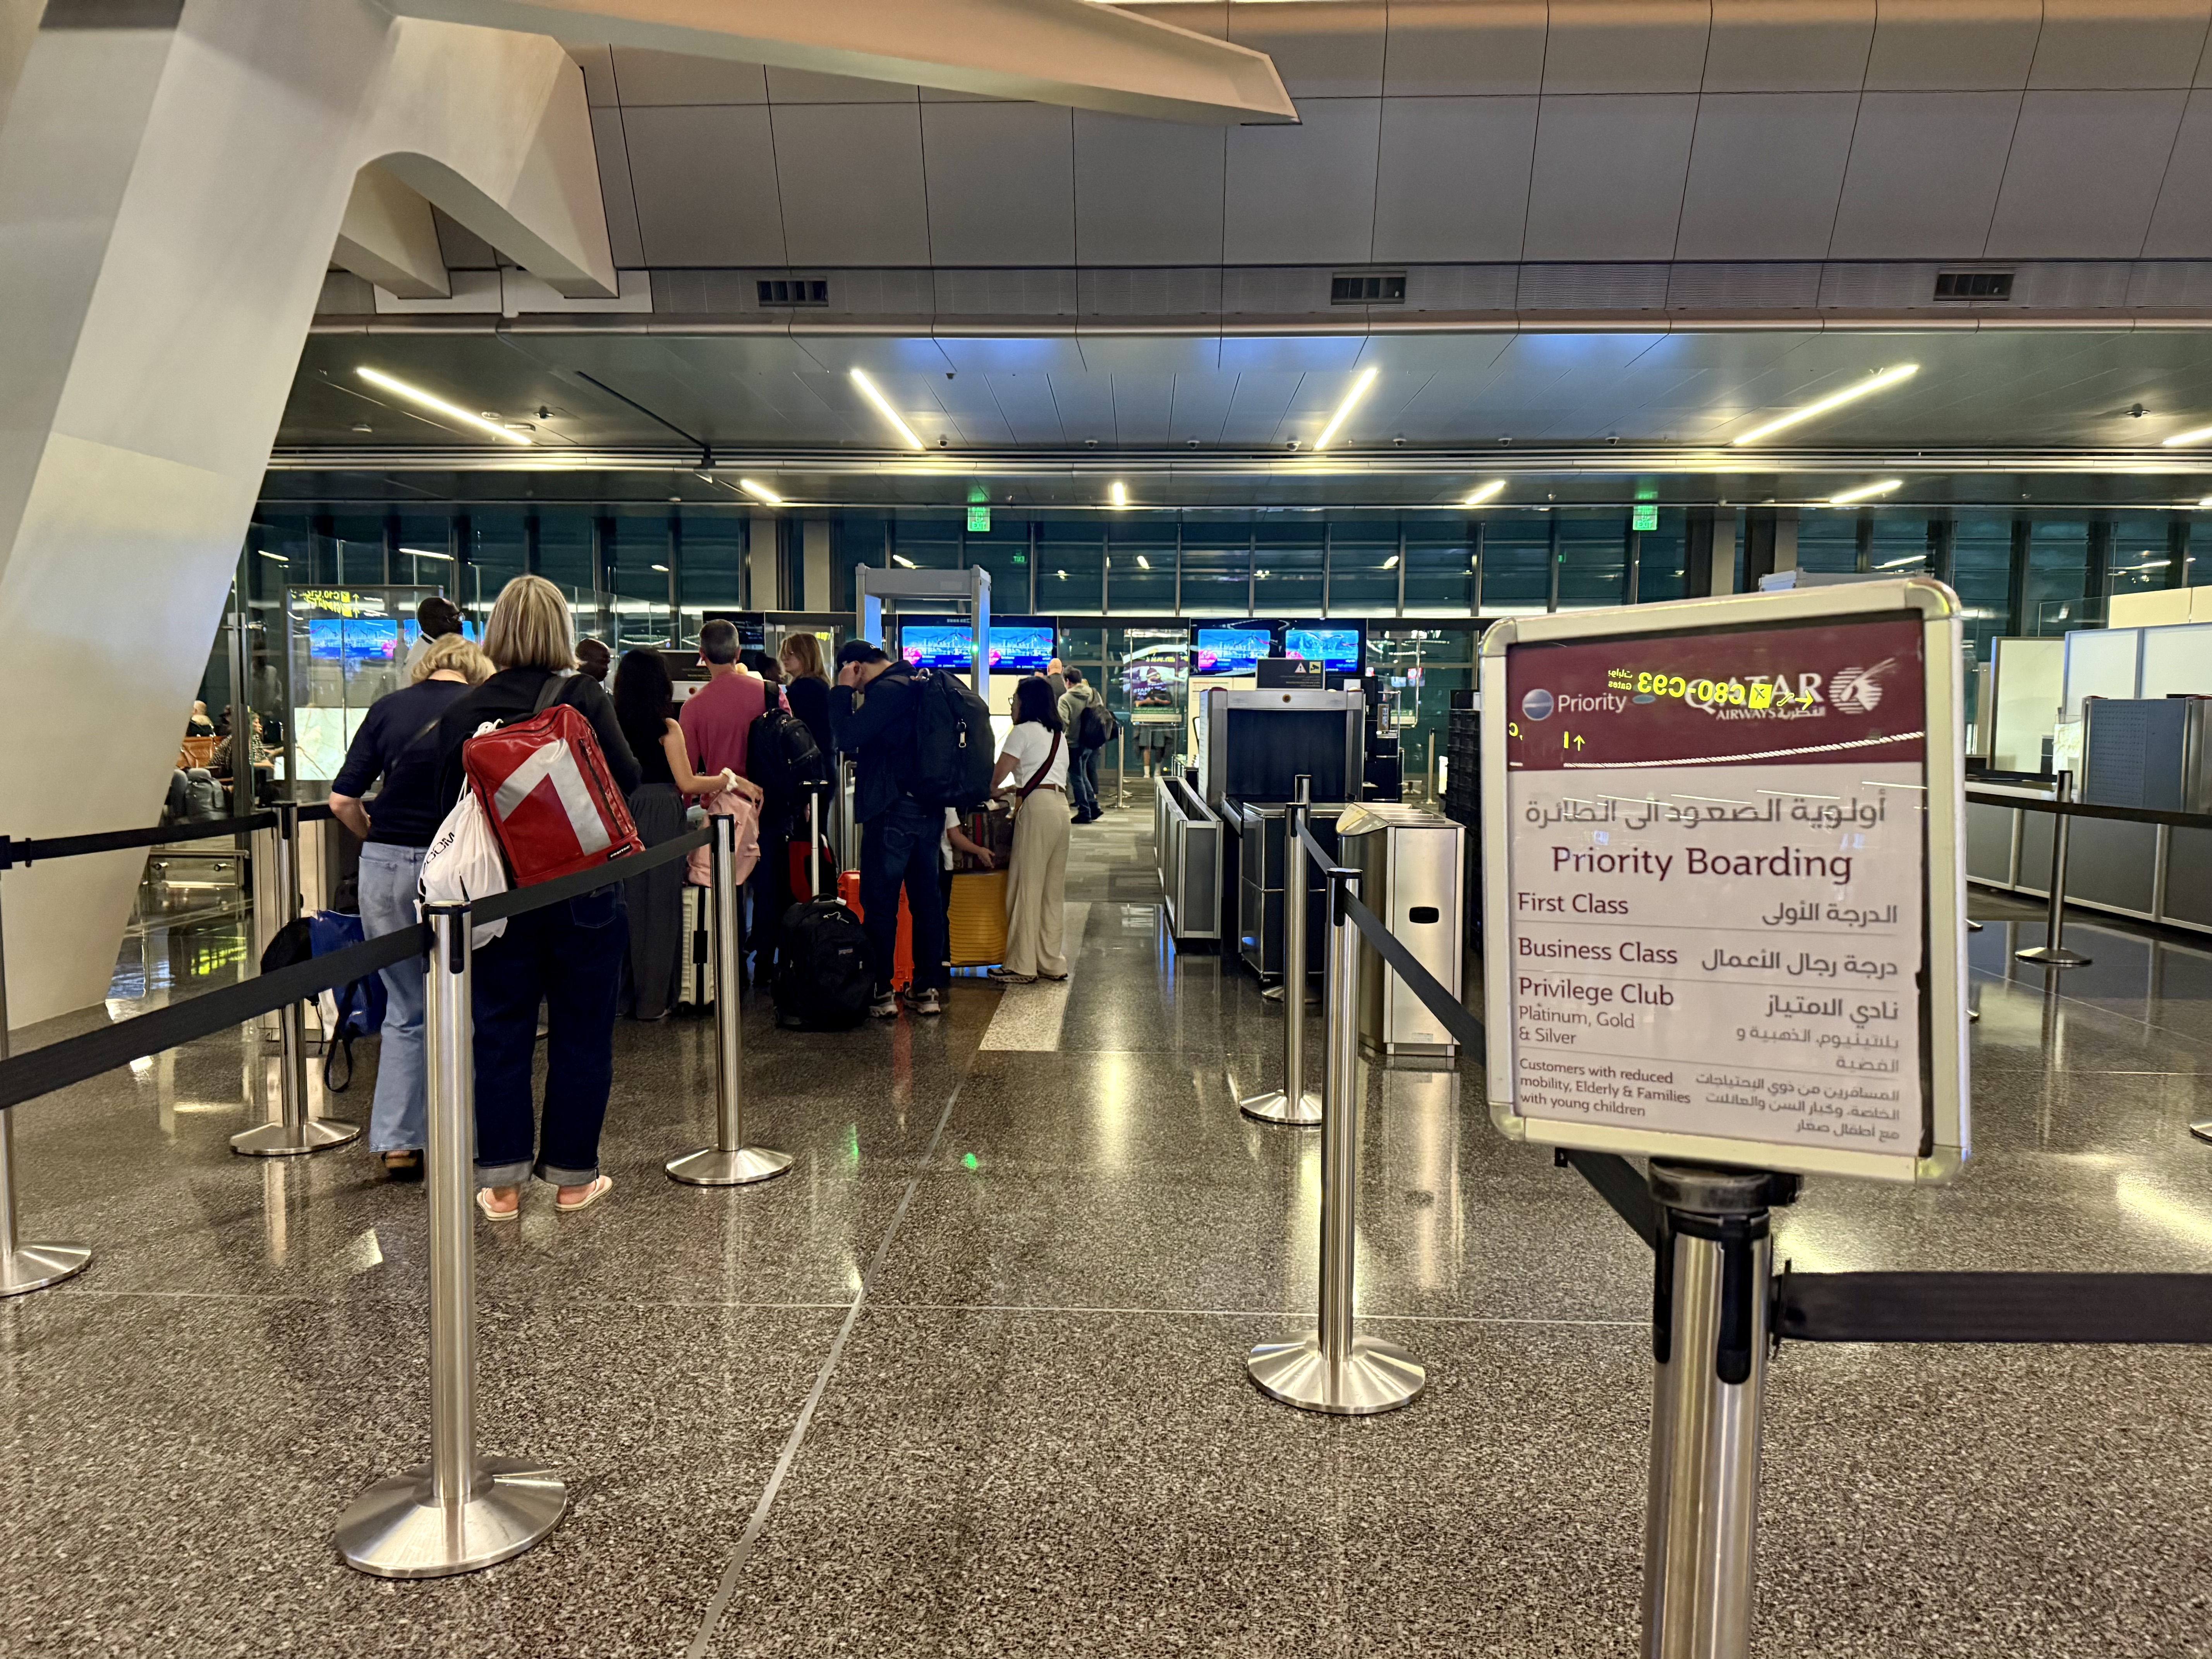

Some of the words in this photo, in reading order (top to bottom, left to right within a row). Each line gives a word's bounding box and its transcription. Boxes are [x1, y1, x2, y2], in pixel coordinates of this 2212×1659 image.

[1558, 692, 1627, 713] Priority
[1716, 708, 1776, 720] AIRWAYS
[1526, 800, 1616, 829] الطائرة
[1668, 798, 1781, 828] الصعود
[1791, 788, 1886, 829] أولوية
[1551, 847, 1673, 881] Priority
[1686, 847, 1853, 885] Boarding
[1518, 892, 1565, 912] First
[1572, 893, 1629, 914] Class
[1762, 900, 1820, 926] الأولى
[1826, 903, 1897, 927] الدرجة
[1518, 938, 1612, 960] Business
[1620, 942, 1678, 964] Class
[1702, 948, 1780, 971] الأعمال
[1787, 953, 1836, 977] رجال
[1844, 955, 1897, 979] درجة
[1519, 977, 1613, 1006] Privilege
[1621, 984, 1674, 1006] Club
[1519, 1005, 1592, 1027] Platinum,
[1597, 1012, 1635, 1028] Gold
[1766, 994, 1843, 1018] الامتياز
[1850, 1001, 1898, 1029] نادي
[1519, 1027, 1530, 1041] &
[1535, 1028, 1576, 1044] Silver
[1737, 1028, 1745, 1041] و
[1750, 1026, 1810, 1042] الذهبية
[1520, 1058, 1585, 1075] Customers
[1589, 1066, 1615, 1079] with
[1620, 1069, 1673, 1084] reduced
[1836, 1056, 1898, 1072] الفضية
[1520, 1076, 1572, 1092] mobility,
[1576, 1080, 1619, 1097] Elderly
[1623, 1085, 1632, 1097] &
[1637, 1087, 1691, 1103] Families
[1798, 1085, 1820, 1096] من
[1824, 1087, 1899, 1101] المسافرين
[1520, 1093, 1547, 1105] with
[1551, 1097, 1590, 1113] young
[1594, 1100, 1645, 1116] children
[1769, 1100, 1805, 1111] السن
[1809, 1101, 1843, 1118] وكبار
[1796, 1118, 1830, 1132] صغار
[1879, 1130, 1899, 1142] مع
